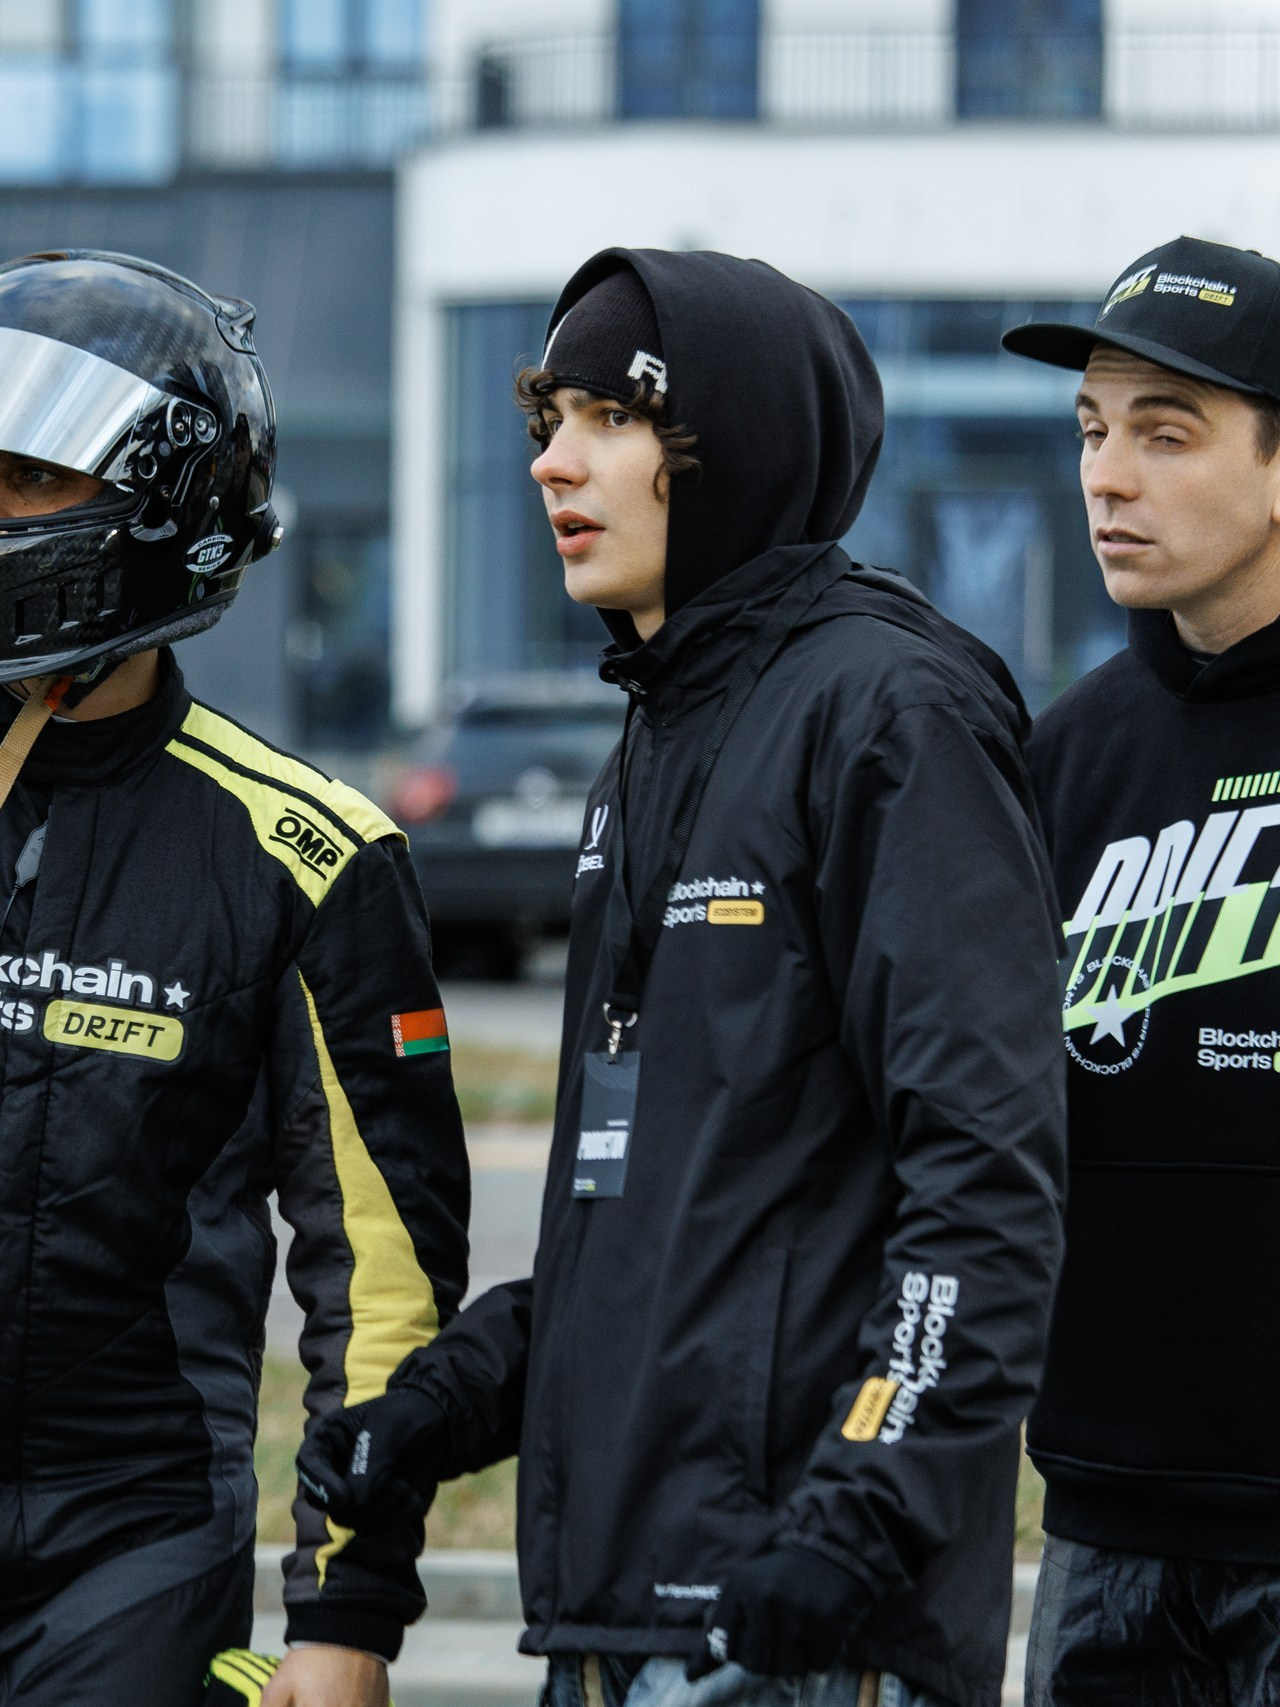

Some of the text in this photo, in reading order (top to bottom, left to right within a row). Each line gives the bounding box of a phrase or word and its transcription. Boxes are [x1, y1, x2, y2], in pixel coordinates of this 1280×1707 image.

[1153, 281, 1229, 304] Sports DRIFT
[1157, 273, 1229, 294] Blockchain
[197, 535, 226, 548] CARBON
[197, 543, 225, 564] GTX3
[274, 815, 339, 867] OMP
[62, 1011, 167, 1049] DRIFT
[1197, 1048, 1273, 1072] Sports
